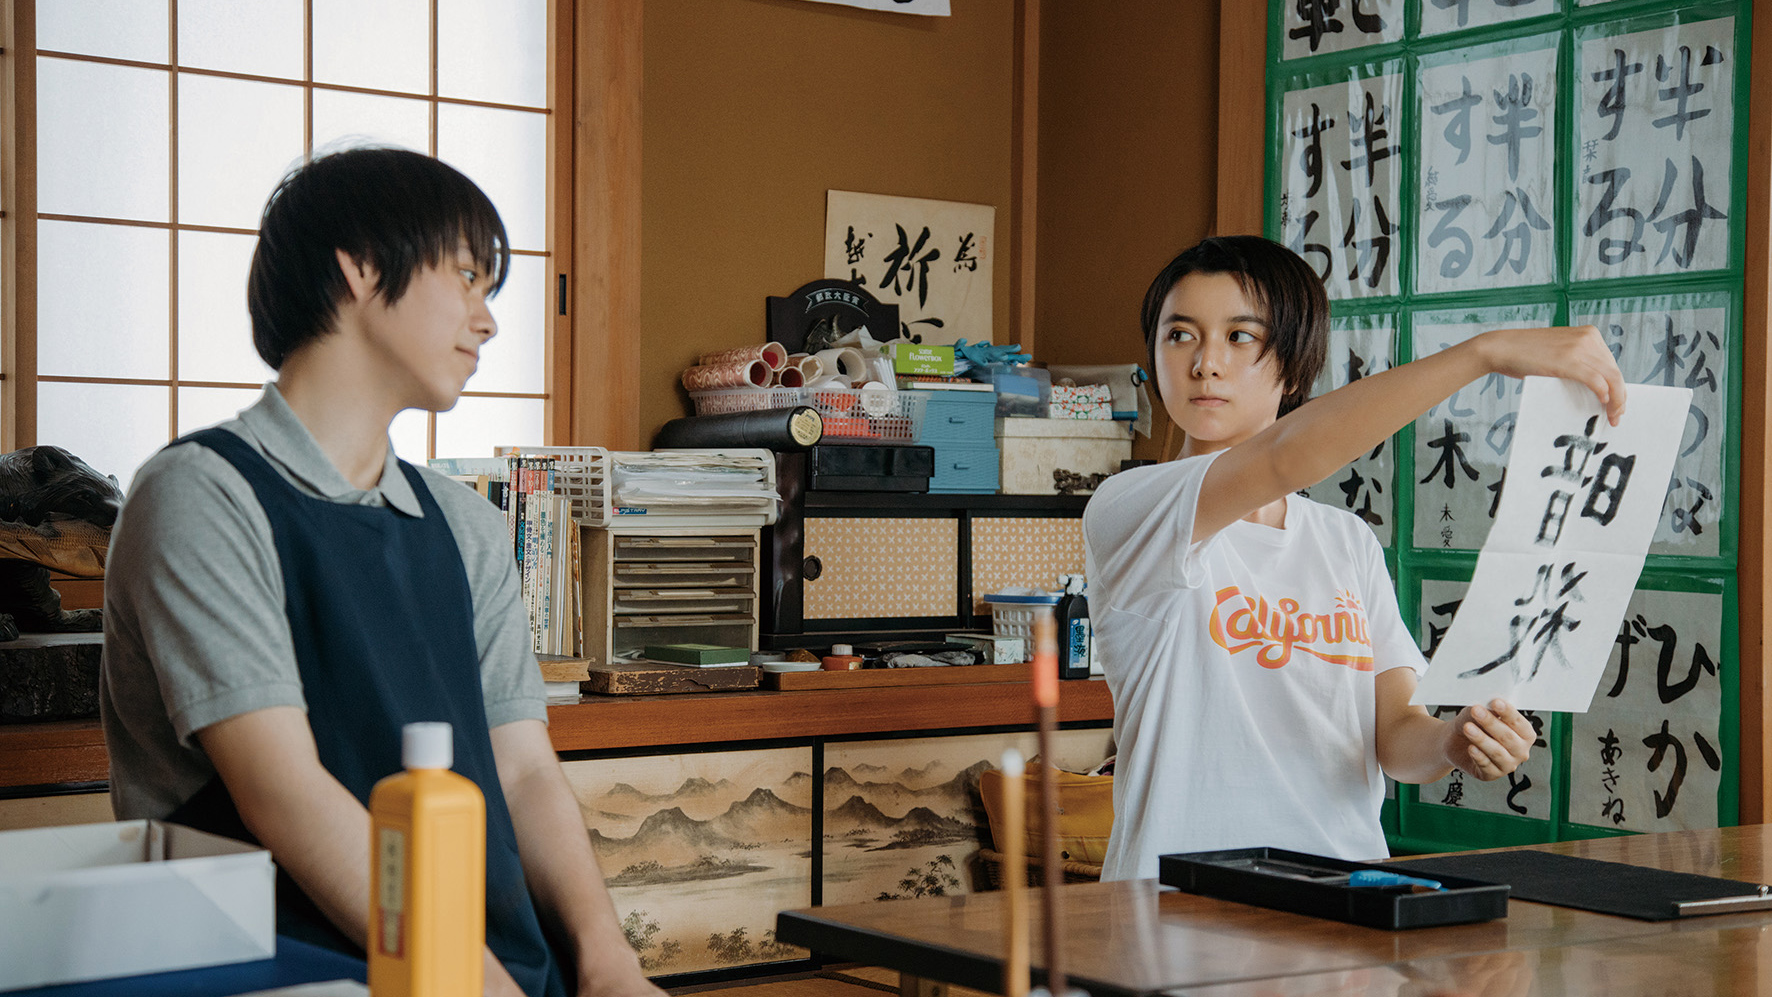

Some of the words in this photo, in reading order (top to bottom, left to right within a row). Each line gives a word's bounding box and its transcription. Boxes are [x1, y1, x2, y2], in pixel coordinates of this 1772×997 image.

[1340, 91, 1400, 288] 半分
[1427, 75, 1482, 279] する
[1484, 72, 1550, 277] 半分
[1583, 48, 1645, 266] する
[1647, 45, 1728, 268] 半分
[1209, 586, 1373, 669] California
[1642, 624, 1721, 819] ひか
[1597, 728, 1626, 825] あきね
